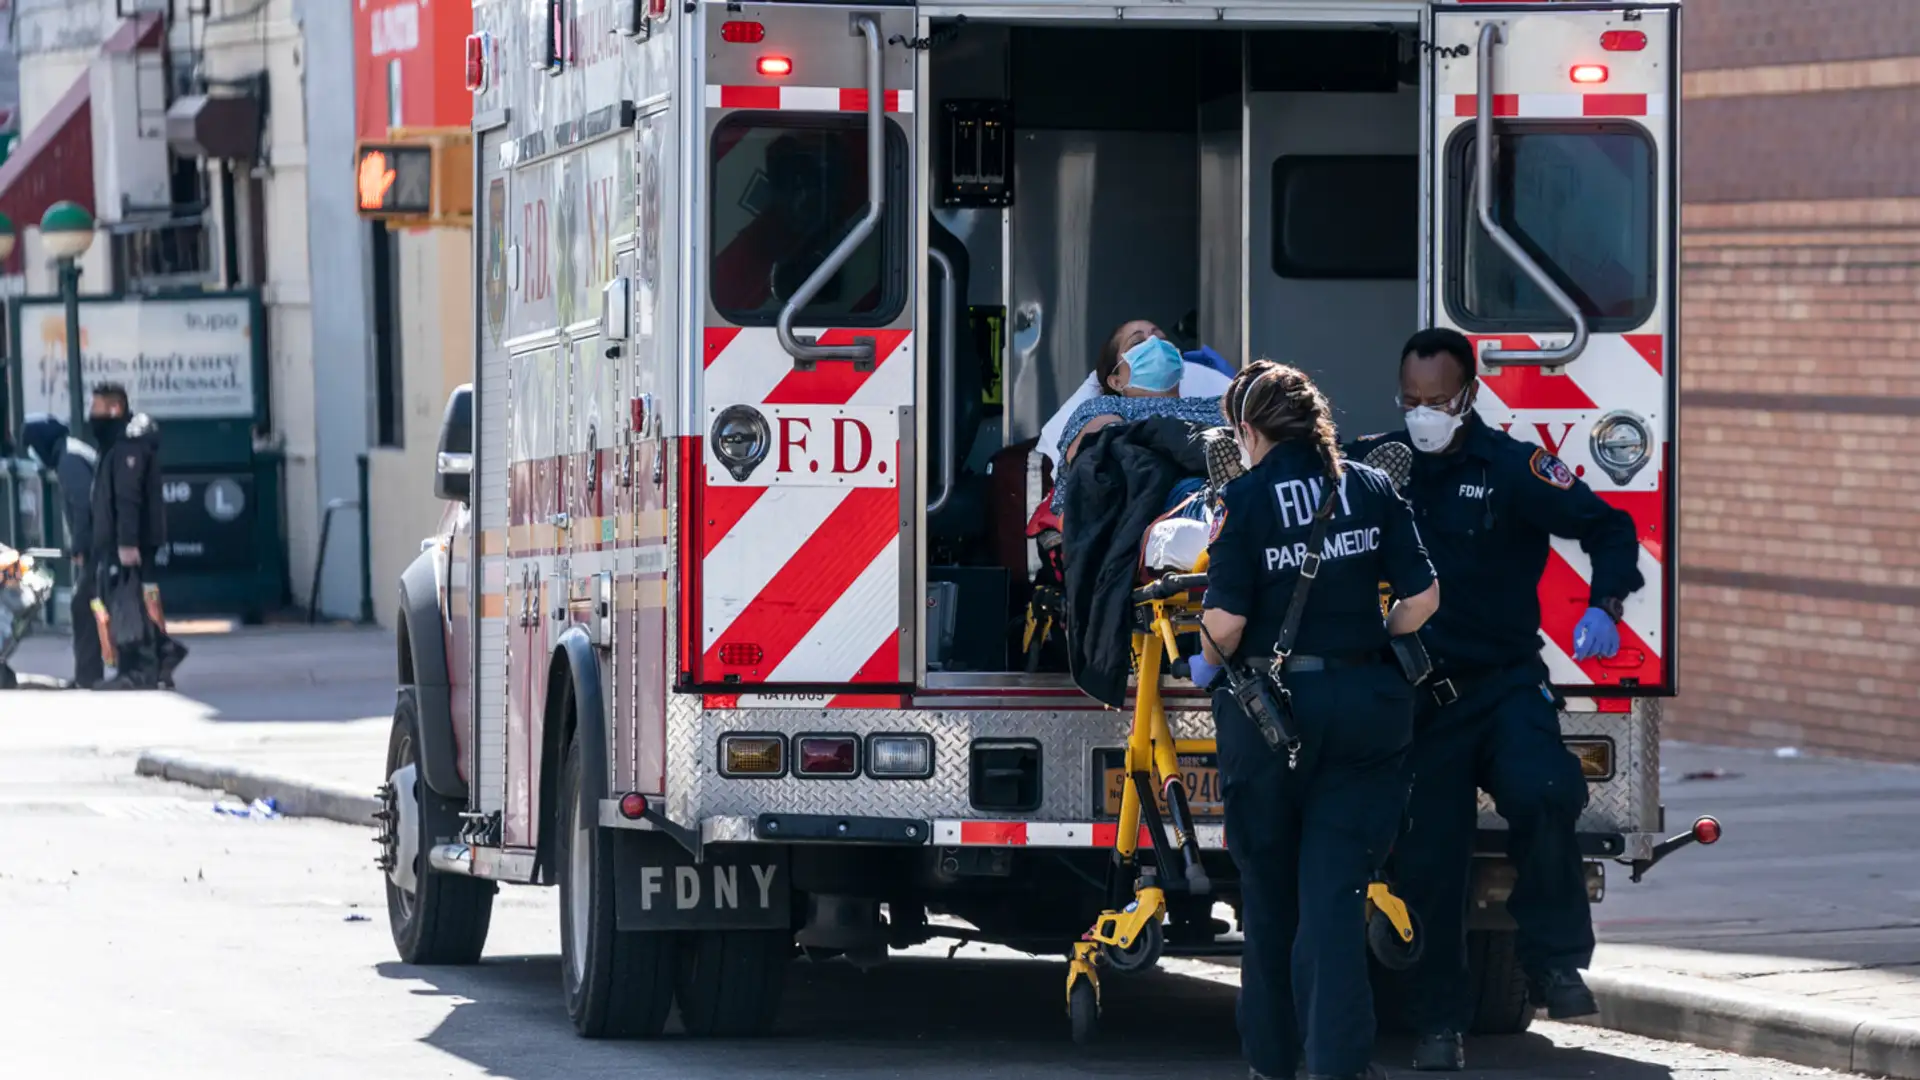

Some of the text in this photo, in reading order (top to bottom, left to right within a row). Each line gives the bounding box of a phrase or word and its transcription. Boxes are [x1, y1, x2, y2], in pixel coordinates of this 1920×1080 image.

[776, 417, 888, 474] F.D.
[162, 481, 235, 515] ue L
[1265, 526, 1380, 571] PARMEDIC
[640, 865, 777, 910] FDNY
